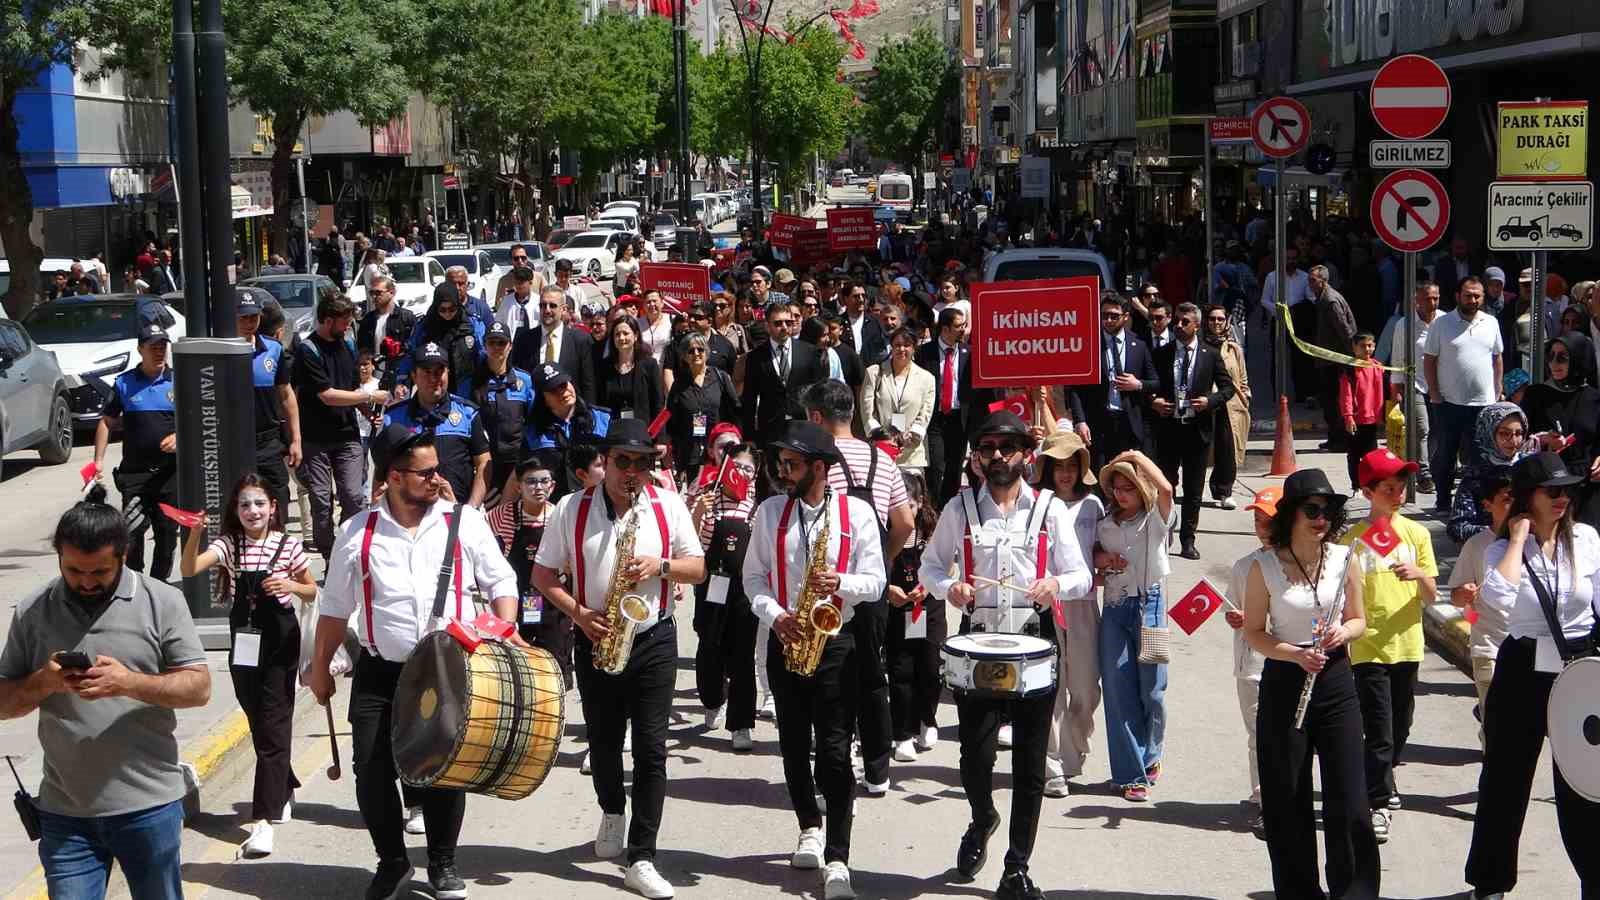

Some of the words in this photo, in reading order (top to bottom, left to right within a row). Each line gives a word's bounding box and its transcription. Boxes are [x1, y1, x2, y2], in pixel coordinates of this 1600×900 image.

[1502, 115, 1540, 128] PARK
[1543, 111, 1585, 128] TAKSİ
[1516, 131, 1571, 148] DURAĞI
[1374, 145, 1445, 162] GİRİLMEZ
[1493, 191, 1544, 207] Aracınız
[1547, 191, 1589, 209] Çekilir
[992, 309, 1077, 329] İKİNİSAN
[987, 337, 1083, 356] İLKOKULU
[199, 365, 216, 401] VAN
[200, 405, 223, 509] BÜYÜKŞEHİR
